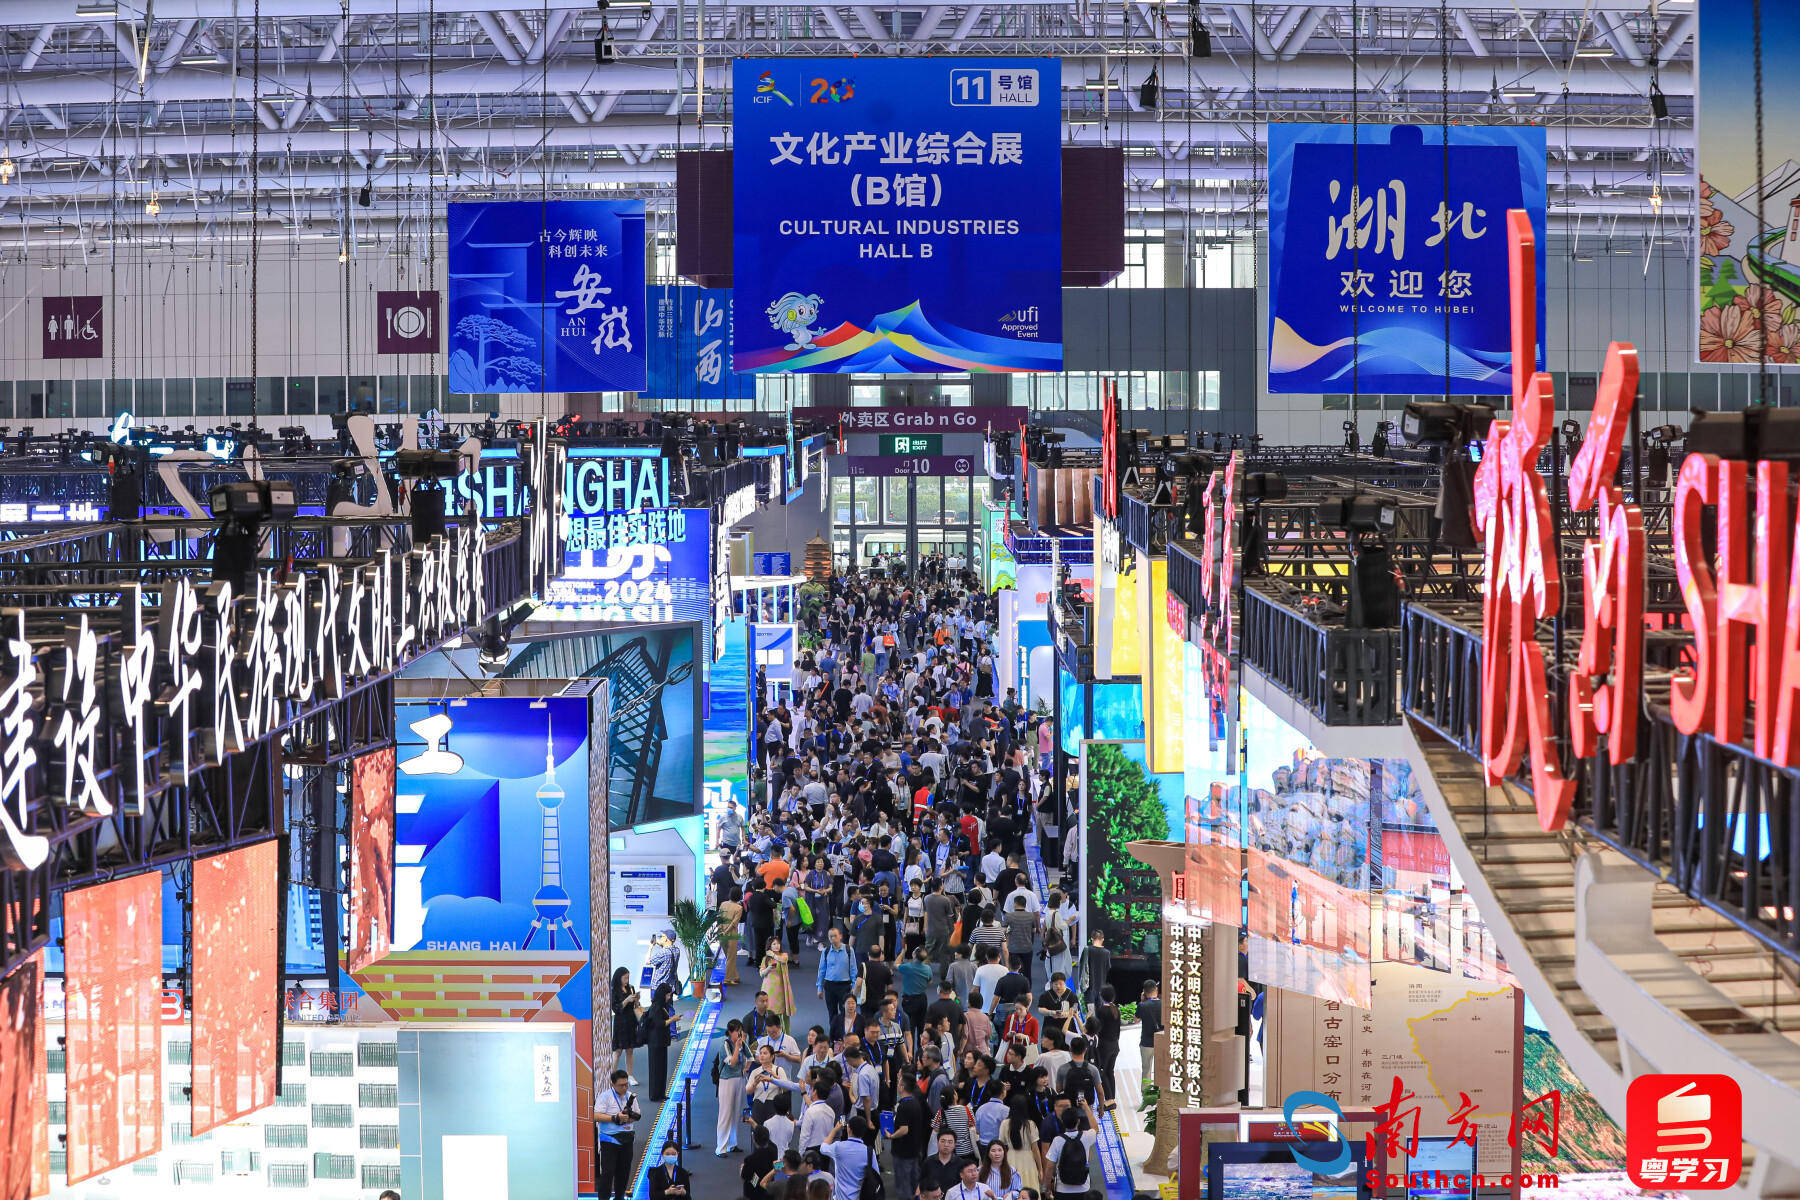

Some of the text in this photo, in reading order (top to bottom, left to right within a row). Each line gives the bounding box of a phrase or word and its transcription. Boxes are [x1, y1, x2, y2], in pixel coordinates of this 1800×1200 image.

[956, 75, 1033, 100] 11 号馆
[999, 93, 1033, 103] HALL
[770, 132, 1023, 165] 文化产业综合展
[851, 173, 942, 207] (B馆)
[780, 220, 1020, 235] CULTURAL INDUSTRIES
[1325, 179, 1488, 261] 湖北
[538, 227, 599, 244] 古今辉映
[548, 244, 608, 259] 科创未来
[860, 243, 933, 258] HALL B
[1340, 269, 1473, 299] 欢迎您
[555, 263, 634, 356] 安徽
[1017, 306, 1039, 322] ufi
[1339, 304, 1475, 314] WELCOME TO HUBEI
[568, 317, 587, 327] AN
[1001, 322, 1039, 333] Approved
[560, 327, 587, 338] HUI
[1017, 330, 1039, 339] Event
[694, 297, 724, 385] 山西
[842, 411, 977, 428] 外卖区 Grab n Go
[911, 458, 931, 474] 10
[604, 580, 673, 604] 2024
[426, 941, 517, 951] SHANG HAI
[1169, 922, 1185, 1094] 中华文化形成的核心区
[1186, 924, 1202, 1109] 中华文明总进程的核心与
